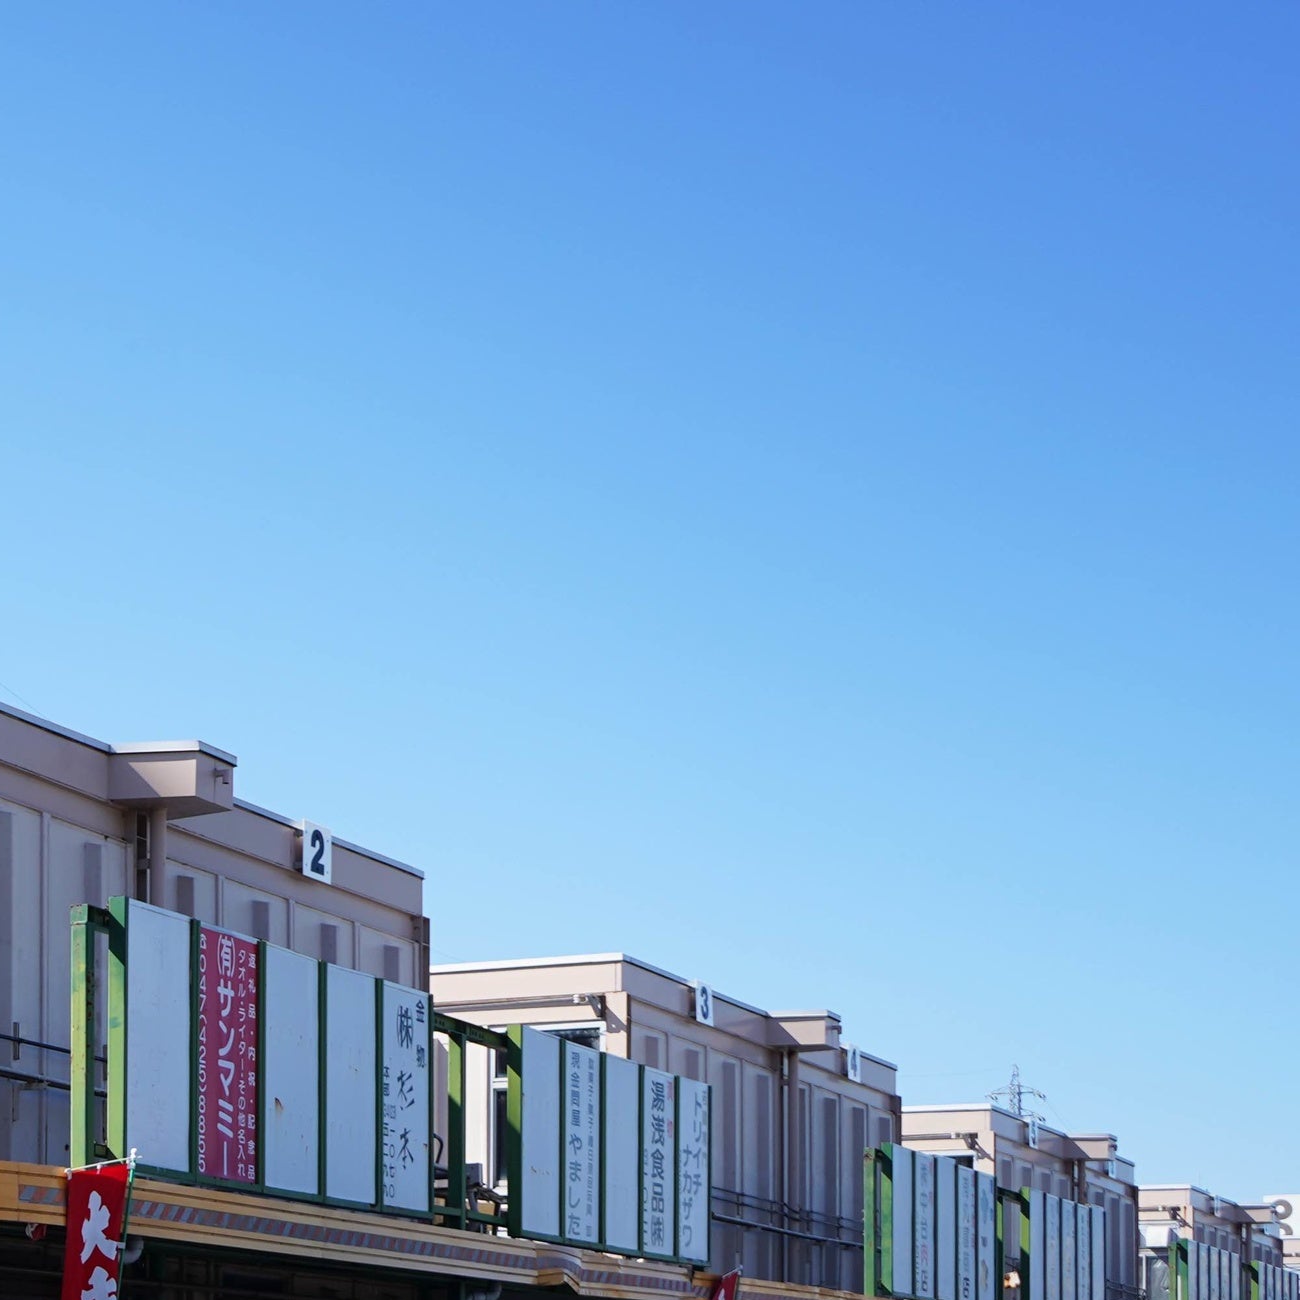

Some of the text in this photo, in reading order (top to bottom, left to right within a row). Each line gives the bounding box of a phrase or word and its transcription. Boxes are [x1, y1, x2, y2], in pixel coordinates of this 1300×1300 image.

[310, 828, 325, 877] 2
[700, 986, 710, 1020] 3
[850, 1047, 857, 1078] 4
[693, 1091, 703, 1196] トリイチ
[681, 1143, 693, 1248] ナカザワ
